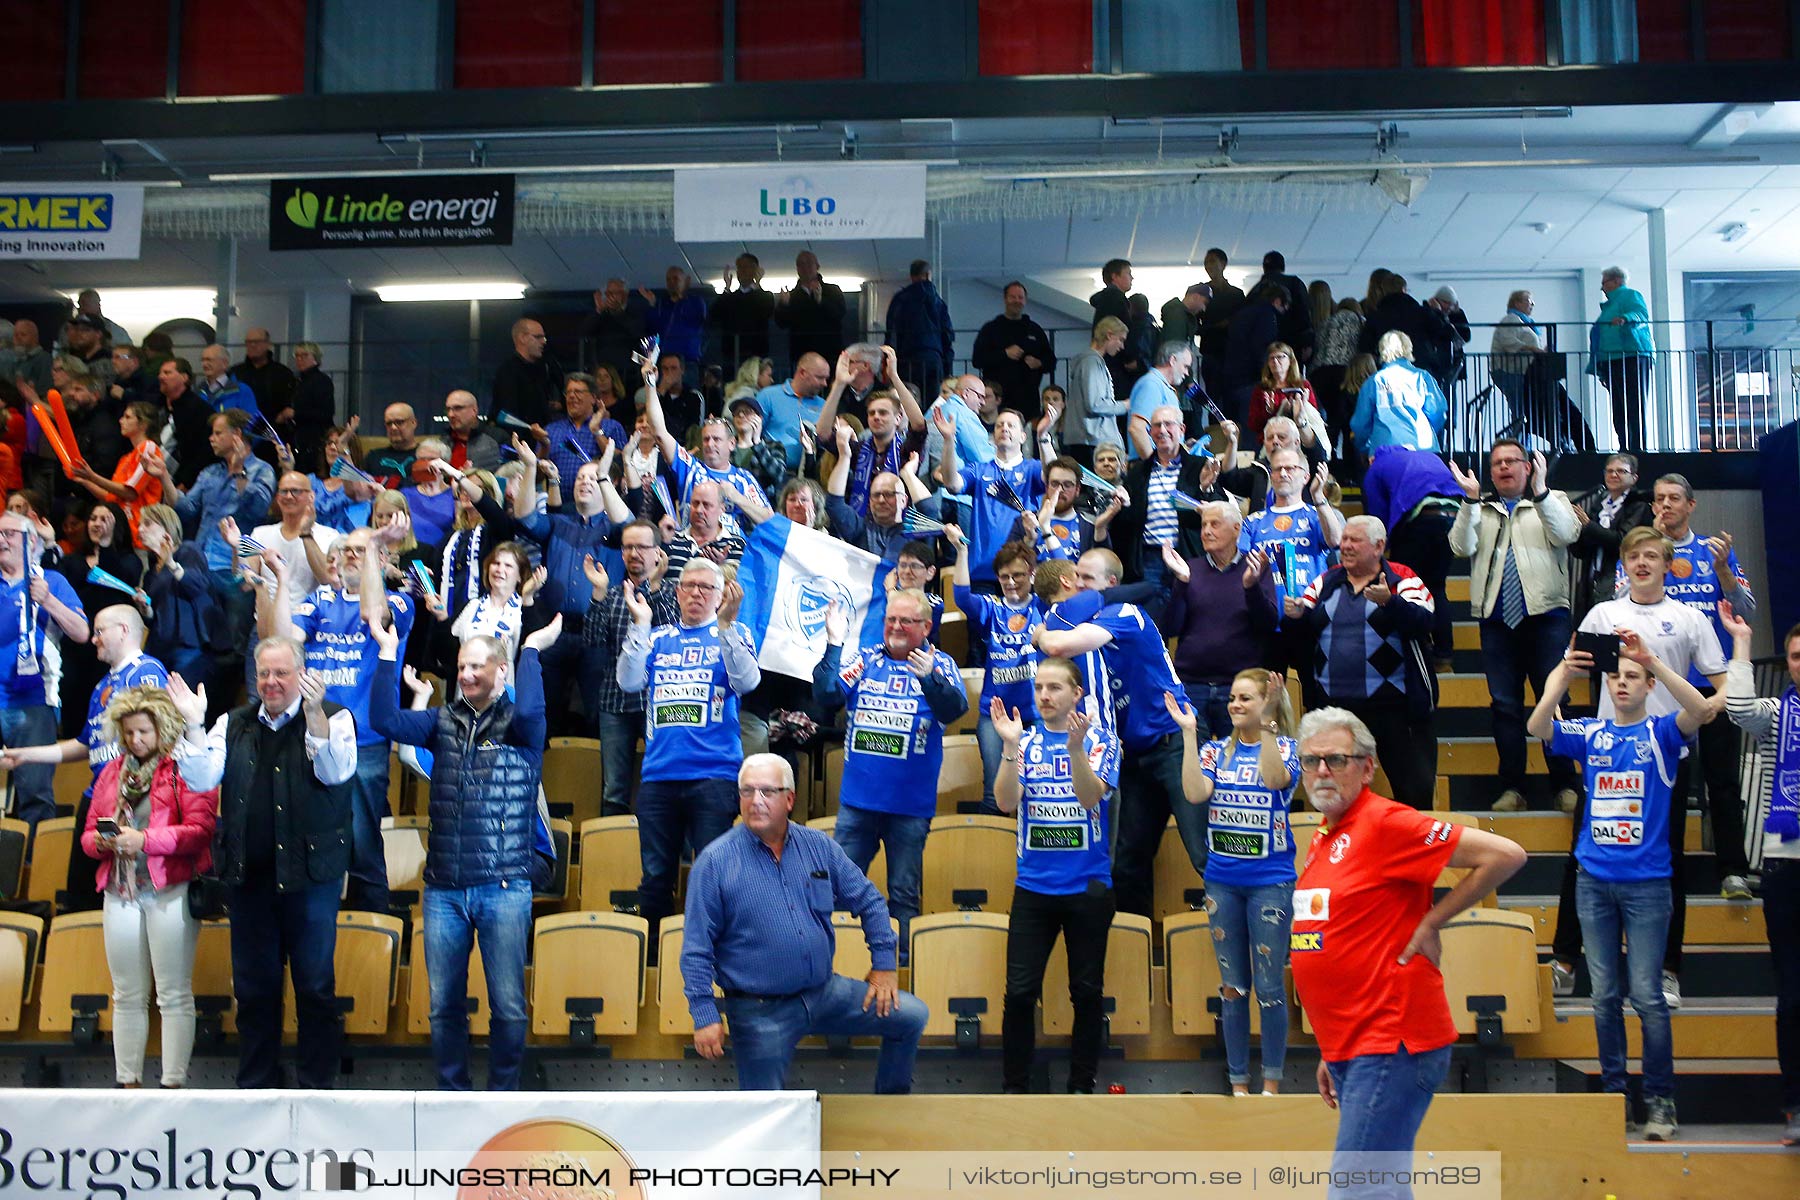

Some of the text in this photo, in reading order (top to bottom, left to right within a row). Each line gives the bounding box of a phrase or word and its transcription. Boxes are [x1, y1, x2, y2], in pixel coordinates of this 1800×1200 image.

[323, 190, 500, 226] Linde energi
[322, 229, 364, 242] Personlig
[399, 228, 421, 239] Kraft
[422, 226, 441, 238] från
[443, 226, 495, 240] Bergslagen.
[27, 239, 105, 252] Innovation
[658, 672, 711, 681] VOLVO
[861, 697, 916, 711] VOLVO
[1593, 730, 1615, 751] 66
[1029, 744, 1043, 763] 6
[1598, 776, 1640, 791] MAXI
[1037, 804, 1086, 818] SKÖVDE
[1219, 809, 1268, 826] SKÖVDE
